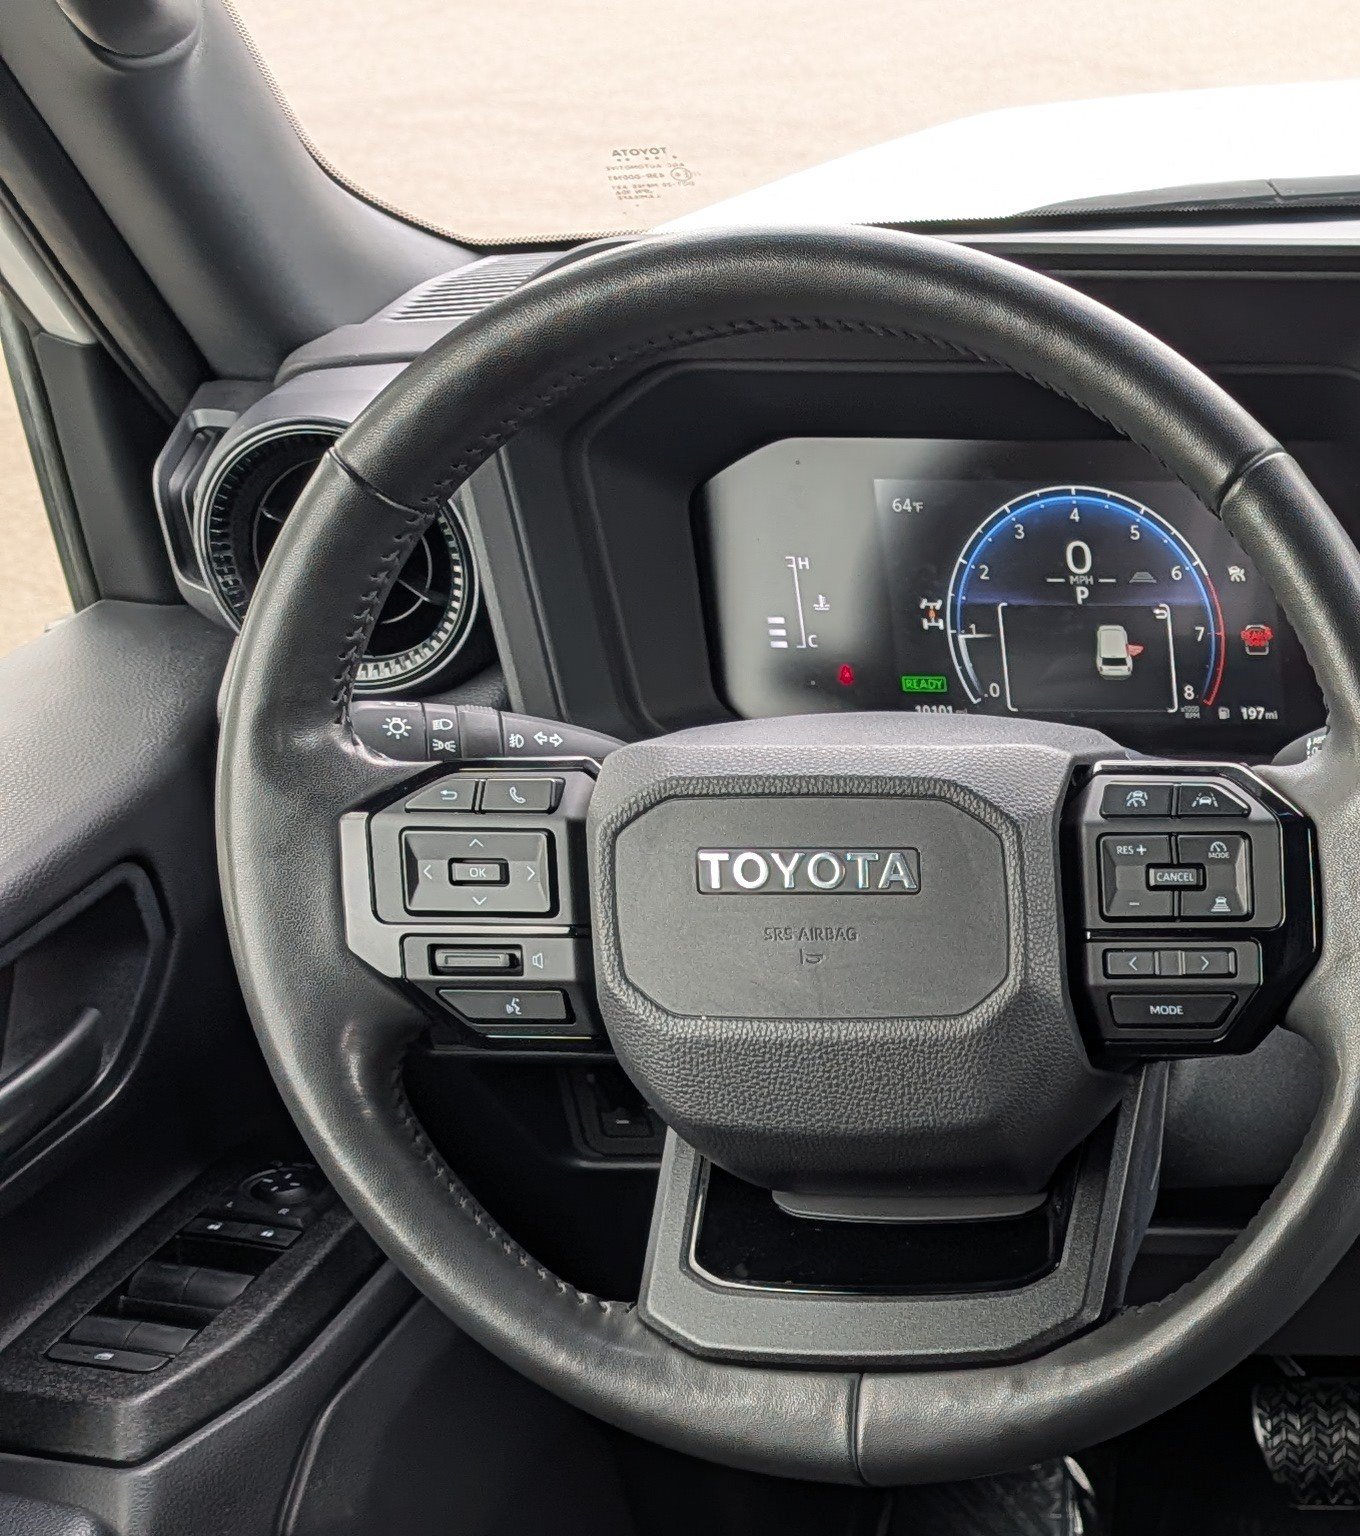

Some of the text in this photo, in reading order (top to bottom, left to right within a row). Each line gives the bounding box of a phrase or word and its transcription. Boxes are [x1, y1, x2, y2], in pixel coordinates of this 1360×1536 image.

[1069, 508, 1080, 523] 4
[1014, 524, 1025, 540] 3
[1130, 525, 1141, 541] 5
[798, 557, 809, 570] H
[1065, 541, 1092, 575] 0
[979, 565, 990, 580] 2
[1069, 575, 1094, 585] MPH
[1171, 565, 1182, 581] 6
[1076, 586, 1089, 605] P
[968, 623, 977, 635] 1
[1194, 626, 1205, 643] 7
[807, 634, 818, 648] C
[905, 679, 943, 689] READY
[989, 683, 1000, 698] 0
[1184, 684, 1195, 700] 8
[1116, 845, 1134, 855] RES
[470, 867, 486, 878] OK
[699, 851, 917, 890] TOYOTA
[1156, 872, 1194, 882] CANCEL
[763, 926, 858, 942] SRS AIRBAG
[1150, 1004, 1183, 1015] MODE
